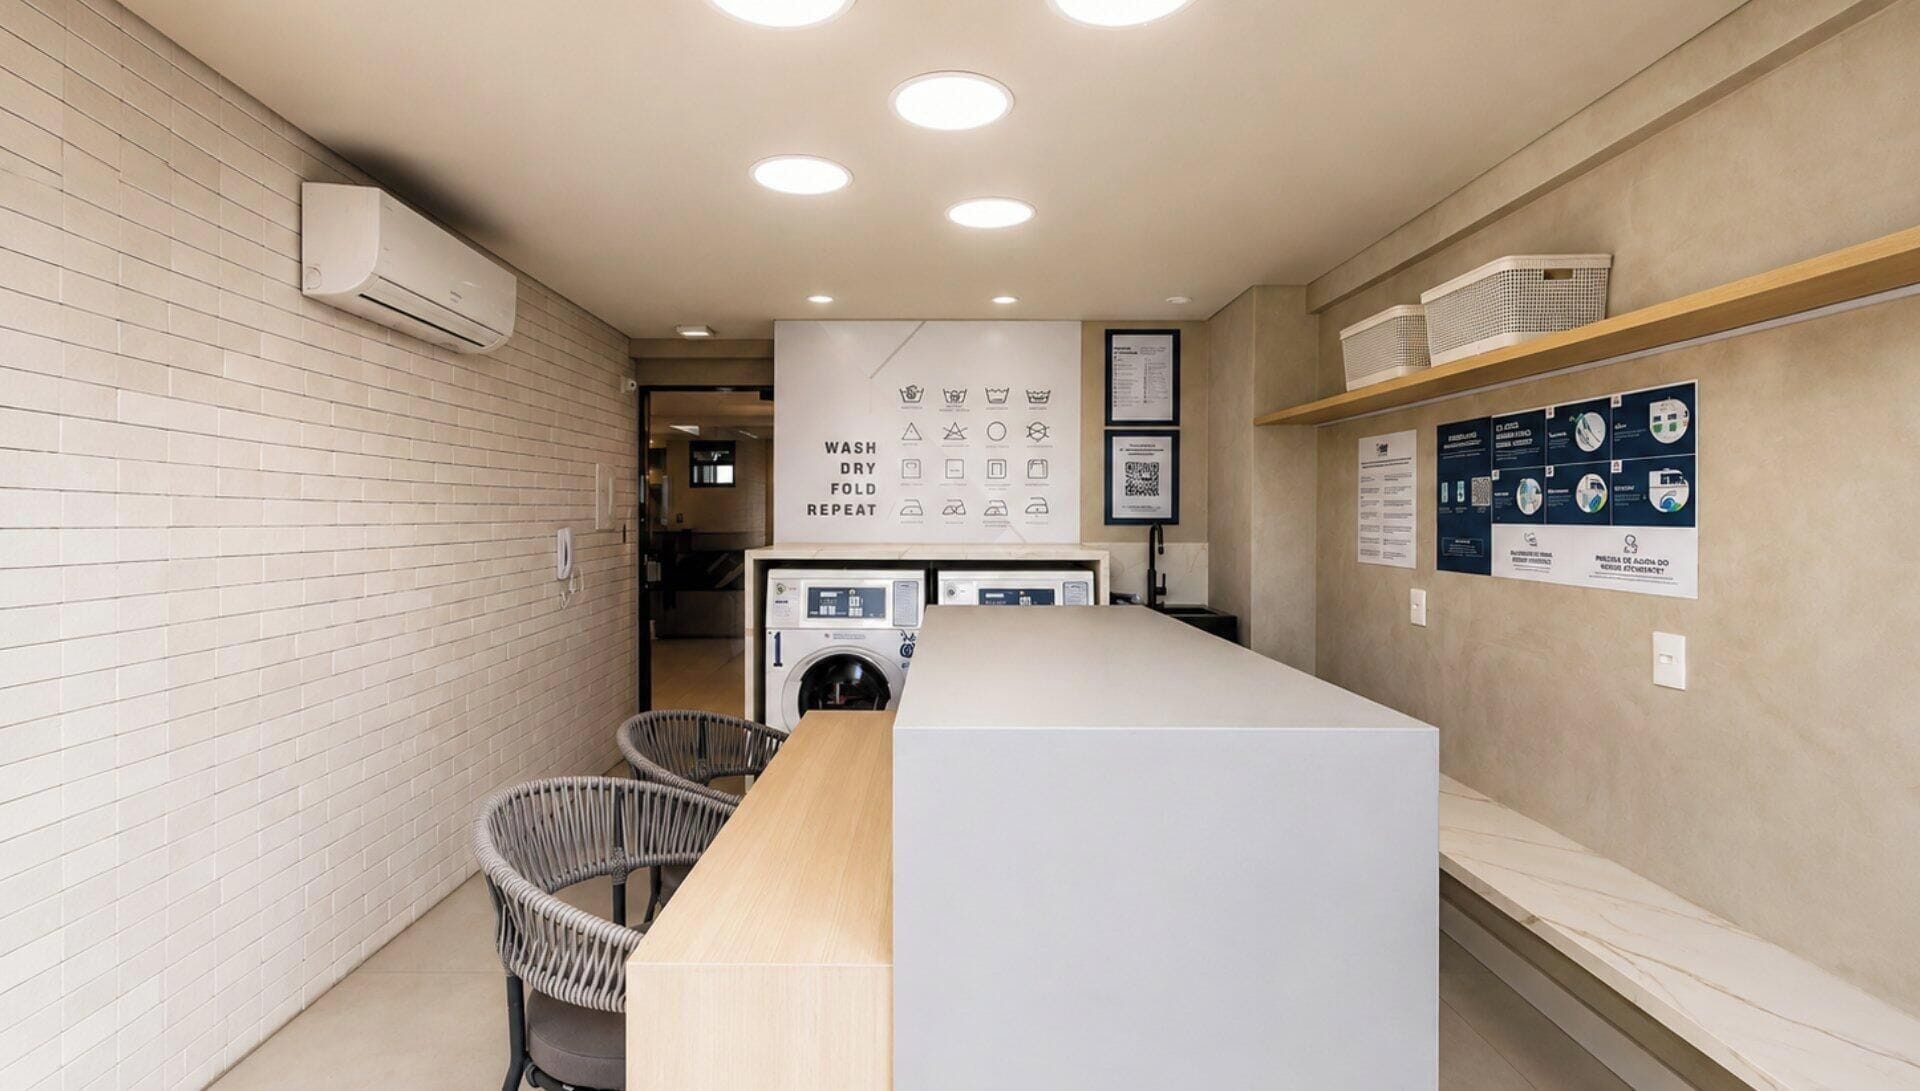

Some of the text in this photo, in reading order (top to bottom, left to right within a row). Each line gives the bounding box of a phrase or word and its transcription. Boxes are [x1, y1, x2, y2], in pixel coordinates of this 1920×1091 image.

[825, 441, 876, 454] WASH
[841, 462, 876, 475] DRY
[831, 483, 876, 495] FOLD
[807, 503, 876, 516] REPEAT
[773, 631, 783, 667] 1
